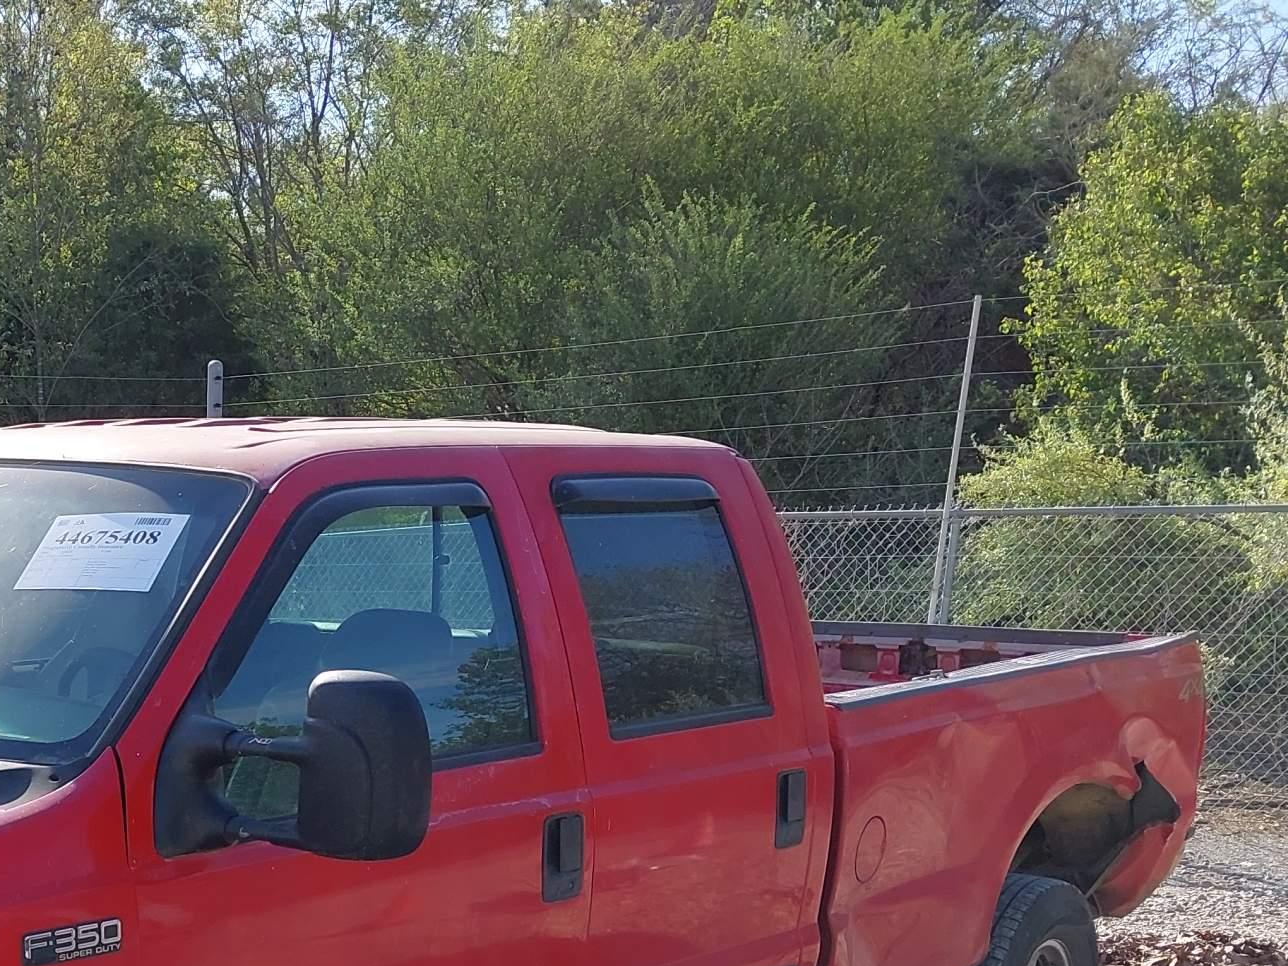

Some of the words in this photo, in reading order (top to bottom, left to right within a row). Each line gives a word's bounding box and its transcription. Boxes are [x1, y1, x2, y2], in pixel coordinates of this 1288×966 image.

[55, 530, 161, 545] 44675408
[58, 948, 93, 961] SUPER
[95, 943, 121, 954] DUTY
